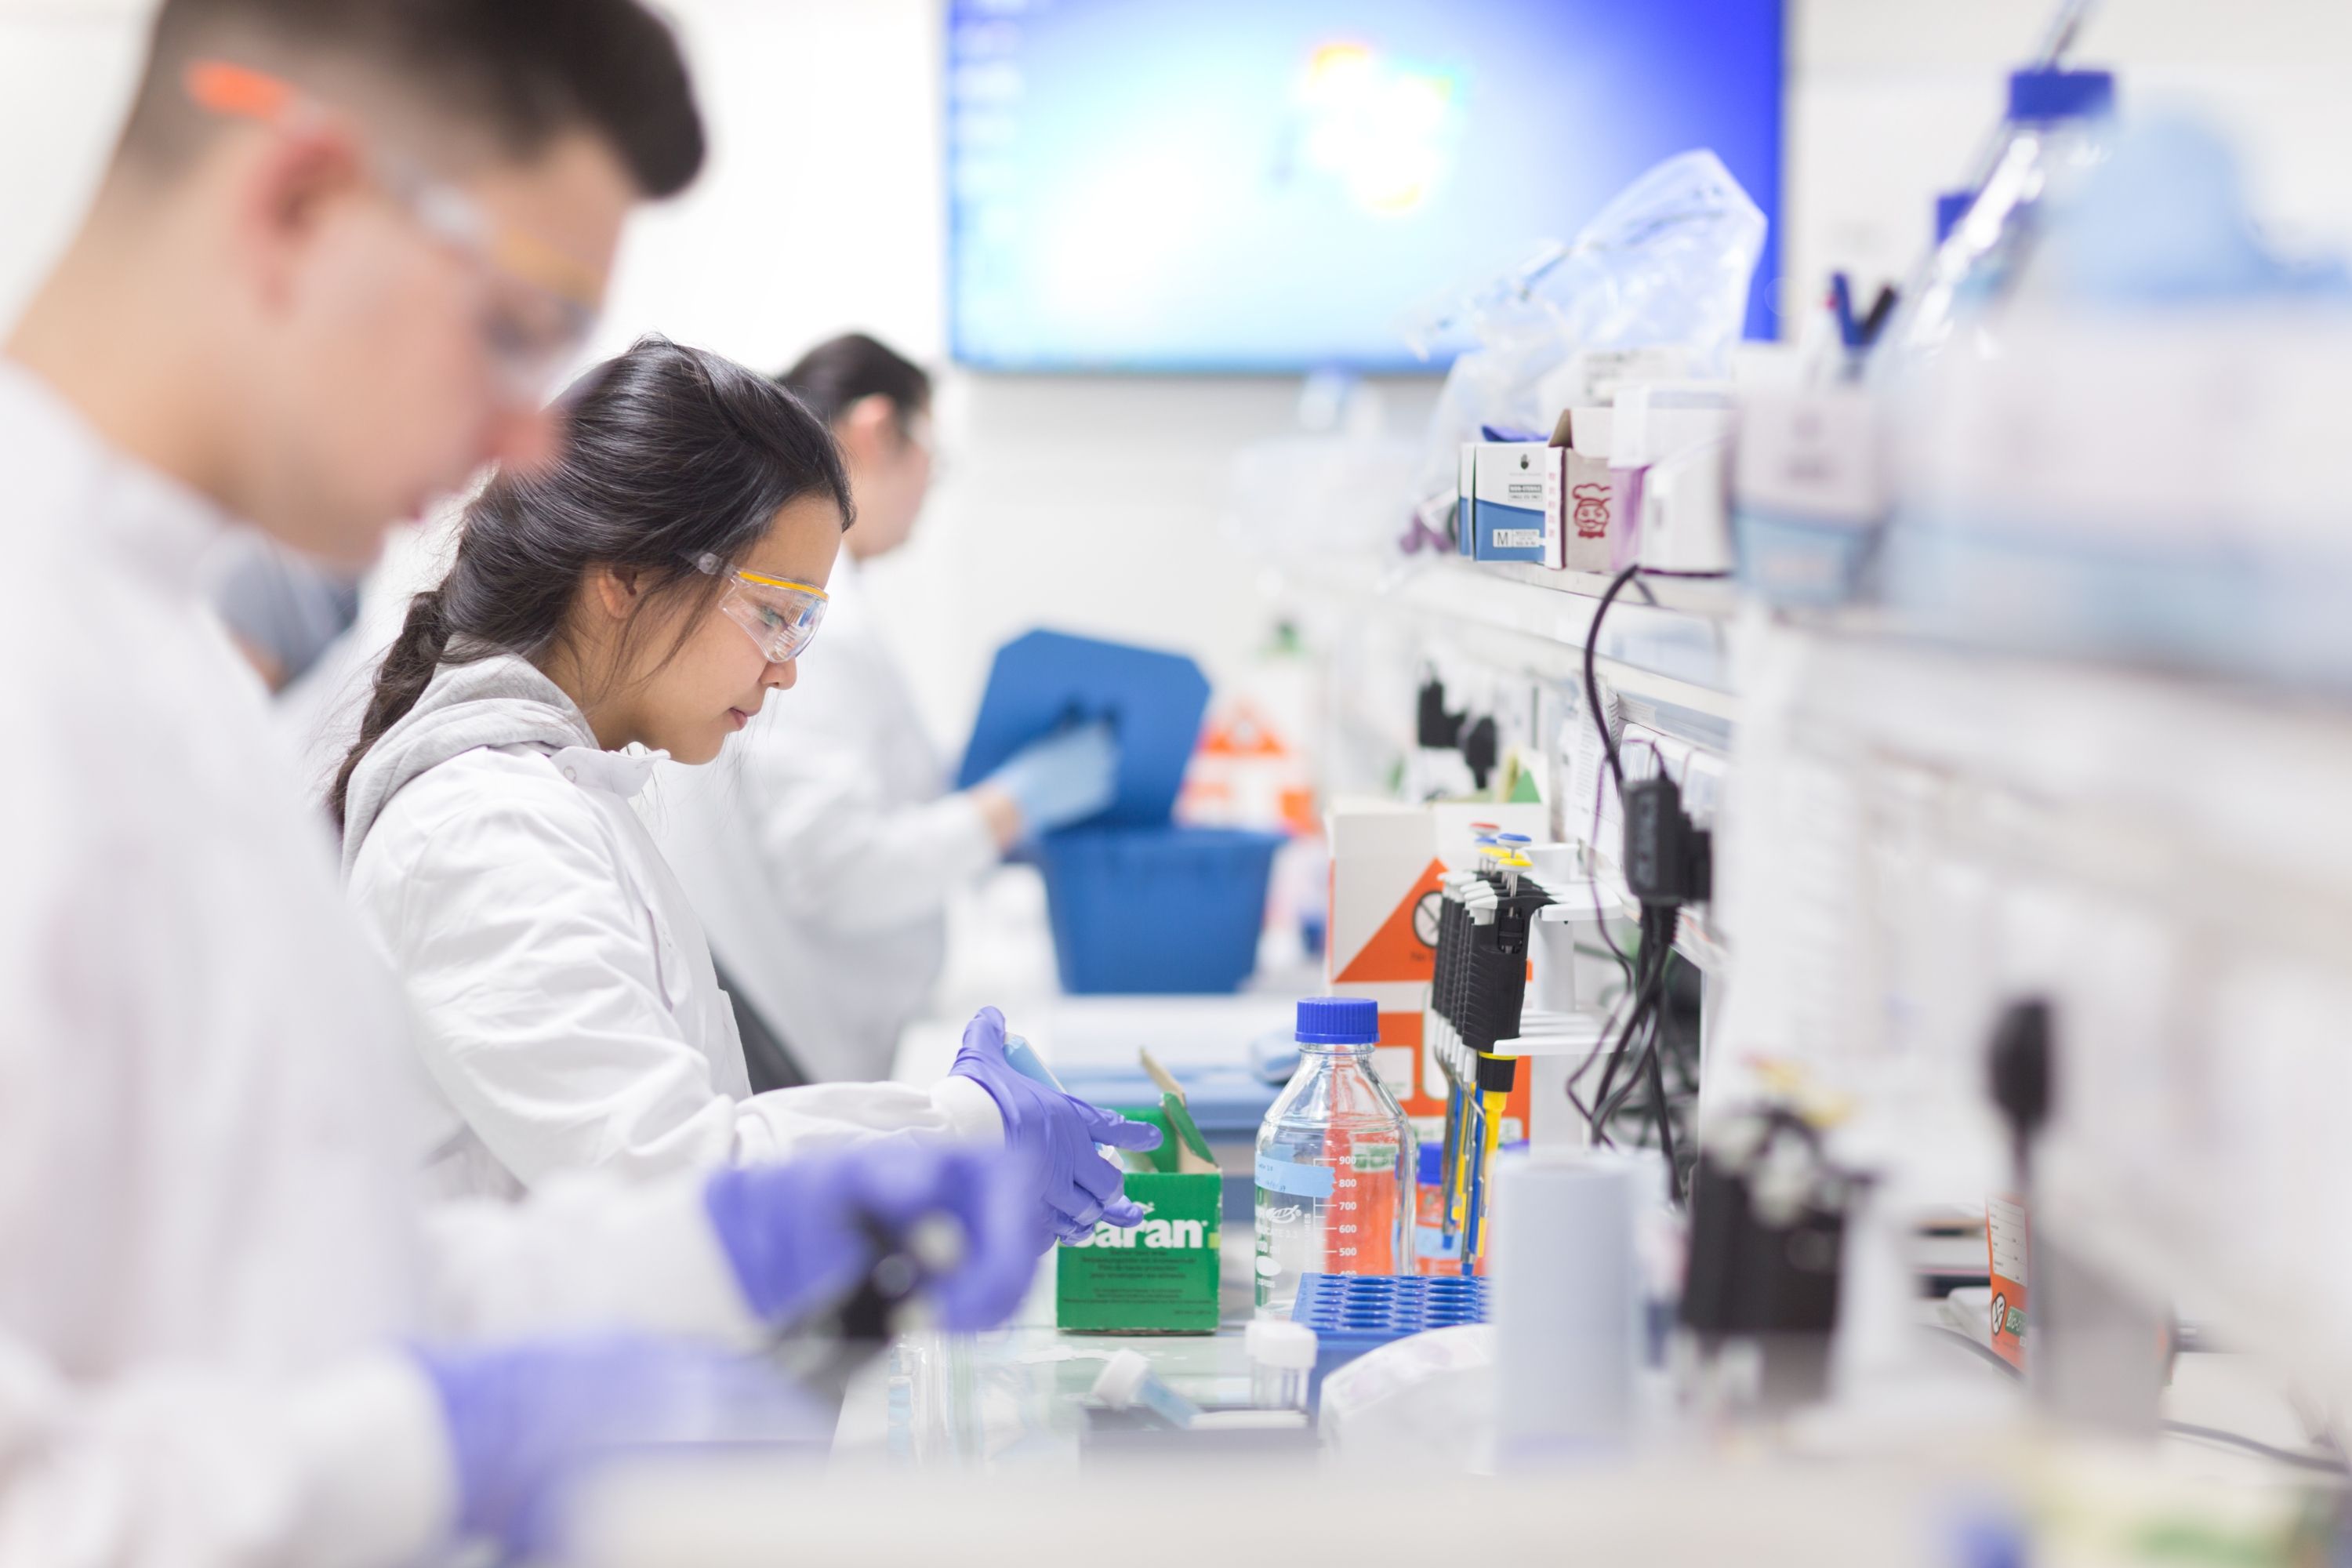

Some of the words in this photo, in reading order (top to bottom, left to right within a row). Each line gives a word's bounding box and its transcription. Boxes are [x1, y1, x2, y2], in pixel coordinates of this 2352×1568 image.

[1497, 531, 1508, 546] M
[1338, 1156, 1356, 1165] 900
[1338, 1178, 1357, 1188] 800
[1338, 1201, 1357, 1211] 700
[1338, 1224, 1357, 1234] 600
[1338, 1247, 1357, 1257] 500
